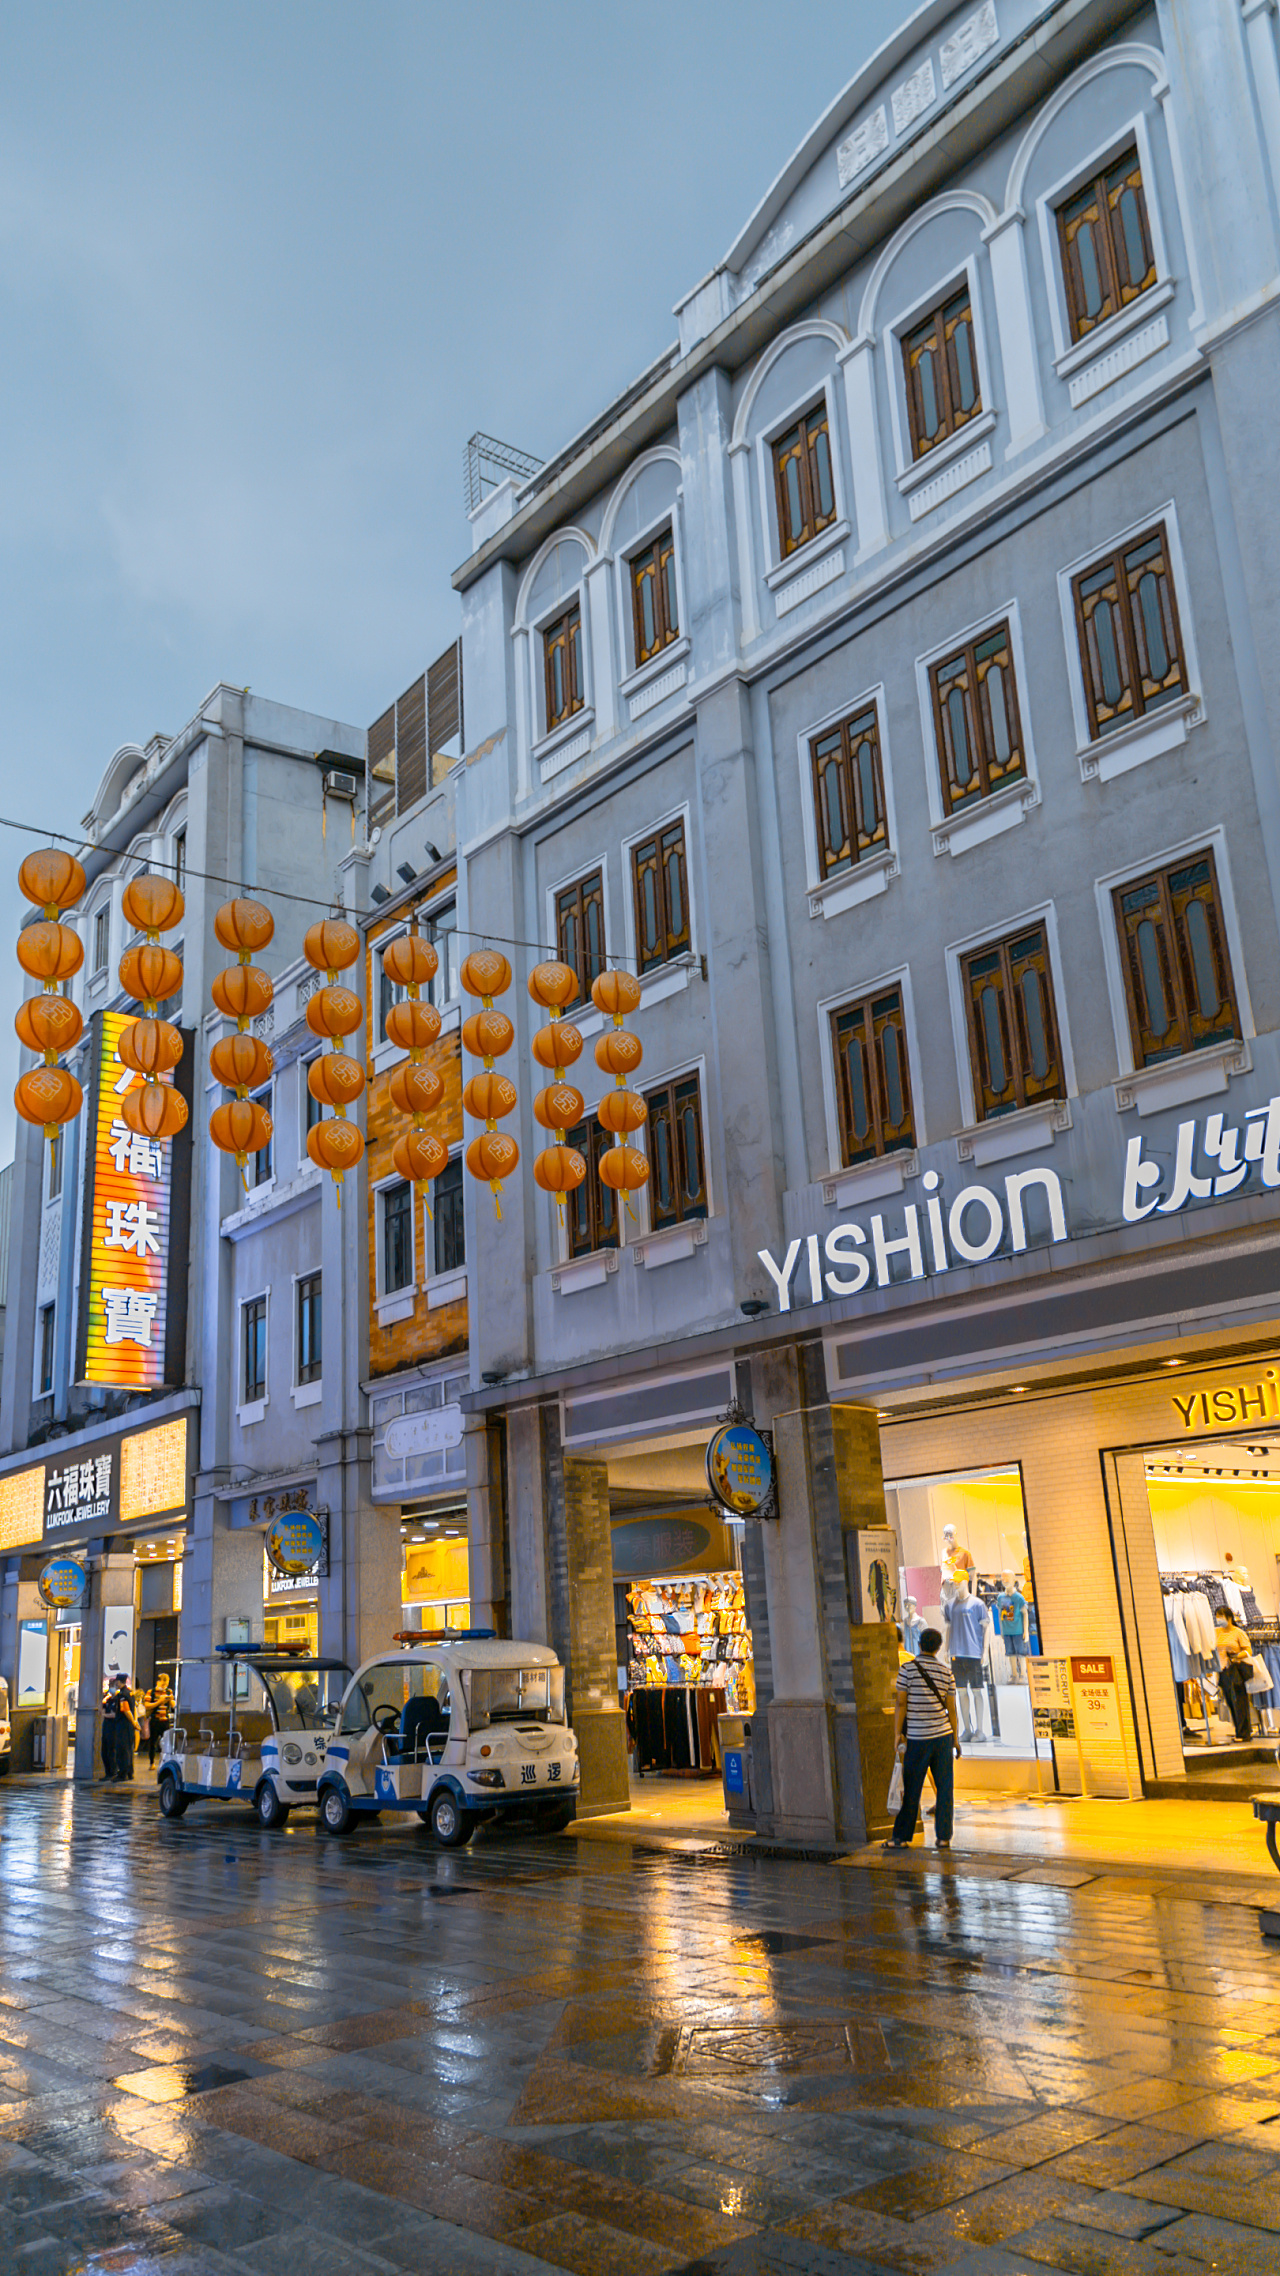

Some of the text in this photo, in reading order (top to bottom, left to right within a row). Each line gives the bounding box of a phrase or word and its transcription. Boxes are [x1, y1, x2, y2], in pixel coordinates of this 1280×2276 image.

[101, 1051, 162, 1348] 福珠寶
[47, 1454, 112, 1512] 六福珠寶
[46, 1499, 110, 1529] LUKFOOK JEWELLERY
[1059, 1659, 1070, 1705] RECRUIT
[1080, 1663, 1105, 1674] SALE
[1081, 1688, 1109, 1697] 全场低至
[521, 1762, 562, 1785] 巡逻
